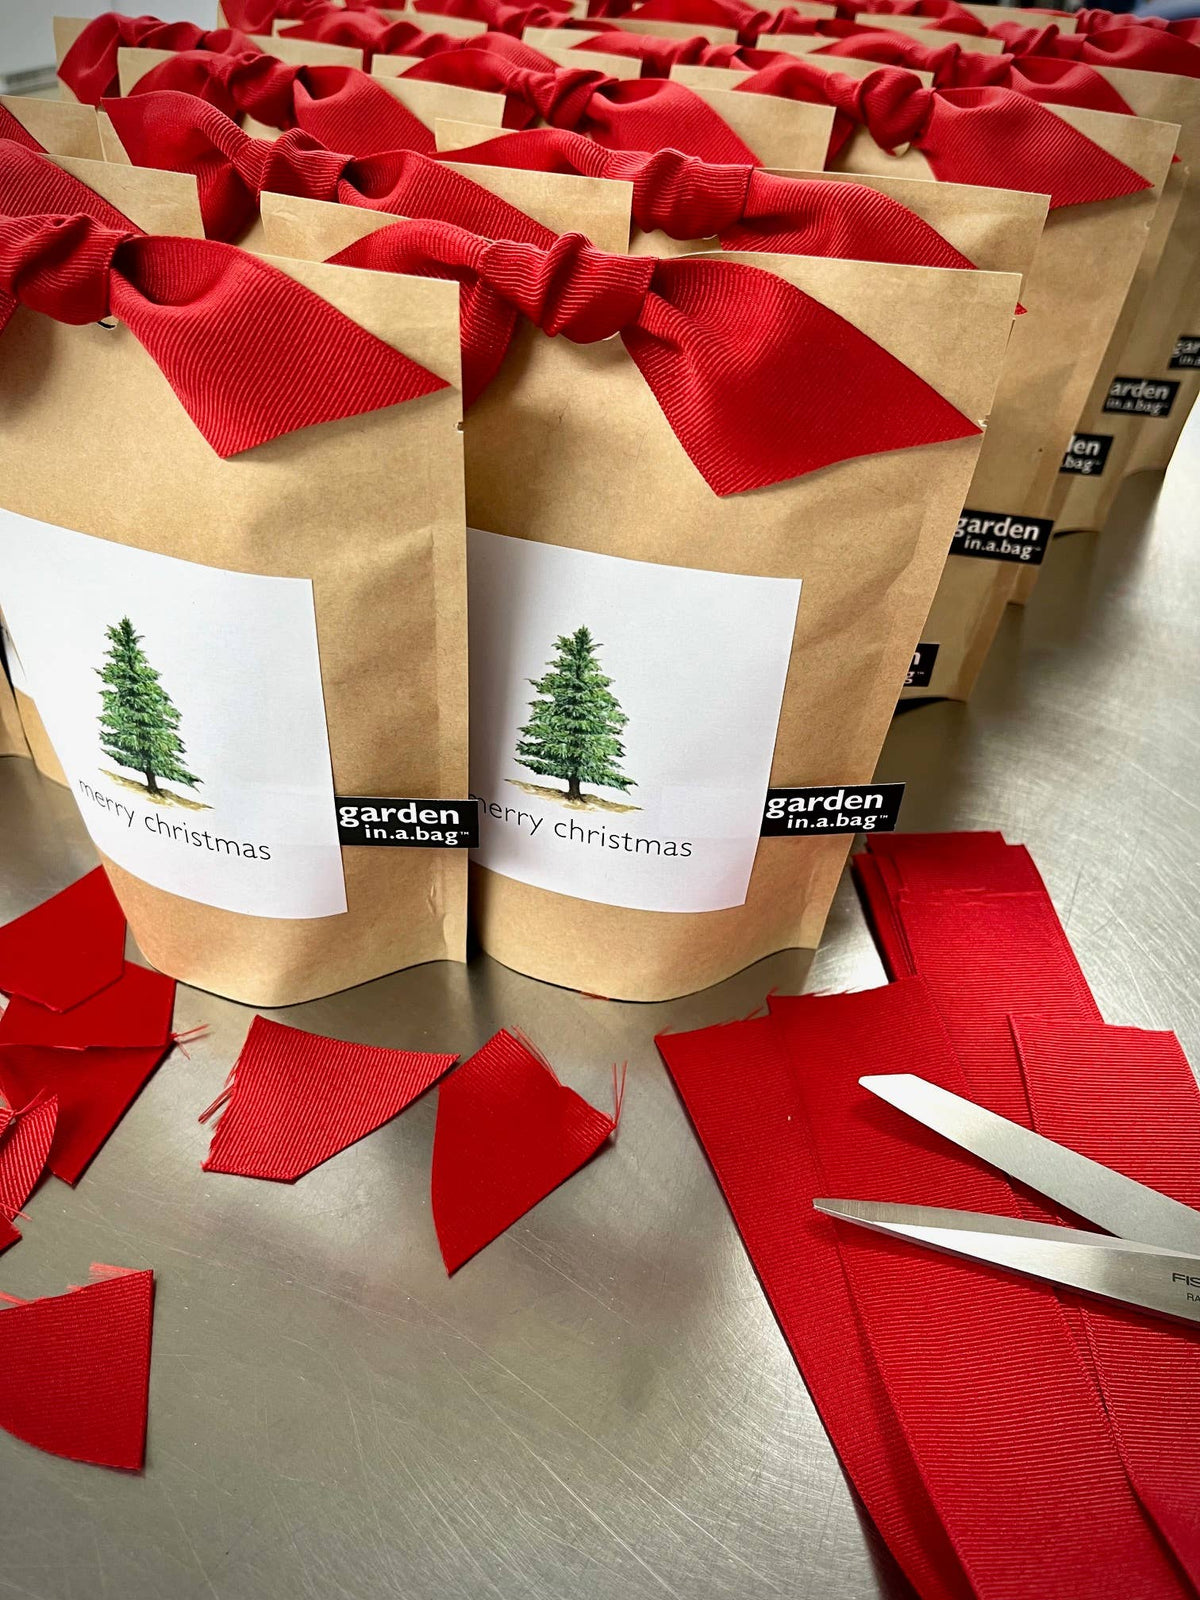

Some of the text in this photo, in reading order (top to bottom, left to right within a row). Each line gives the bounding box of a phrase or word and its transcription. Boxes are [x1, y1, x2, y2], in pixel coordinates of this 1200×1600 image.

[954, 517, 1040, 541] garden
[339, 802, 460, 828] garden
[765, 789, 884, 819] garden
[79, 779, 272, 861] merry christmas
[554, 819, 693, 857] christmas
